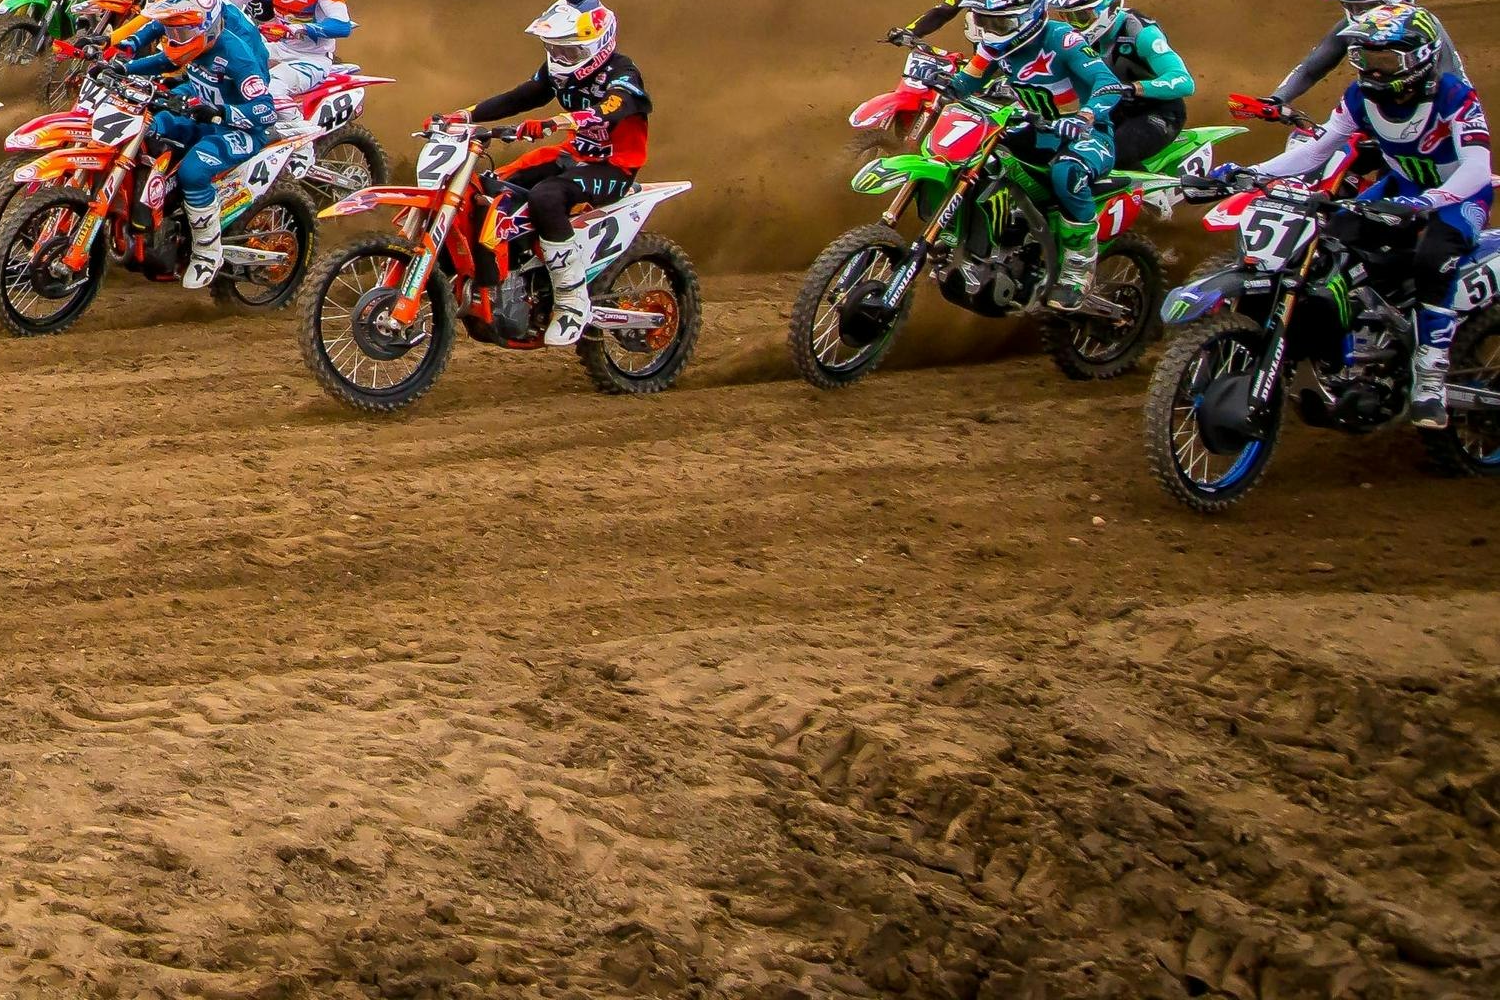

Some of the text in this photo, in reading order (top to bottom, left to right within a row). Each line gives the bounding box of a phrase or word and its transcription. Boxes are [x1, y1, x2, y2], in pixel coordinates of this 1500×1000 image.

[576, 60, 601, 80] Red
[93, 111, 136, 146] 4
[317, 93, 354, 131] 48
[938, 120, 982, 148] 1
[248, 159, 270, 187] 4
[418, 144, 457, 180] 2
[1108, 199, 1125, 236] 1
[1246, 209, 1311, 259] 51
[588, 216, 623, 265] 2
[888, 261, 918, 308] DUNLOP
[1463, 264, 1499, 305] 51
[1260, 335, 1286, 402] DUNLOP
